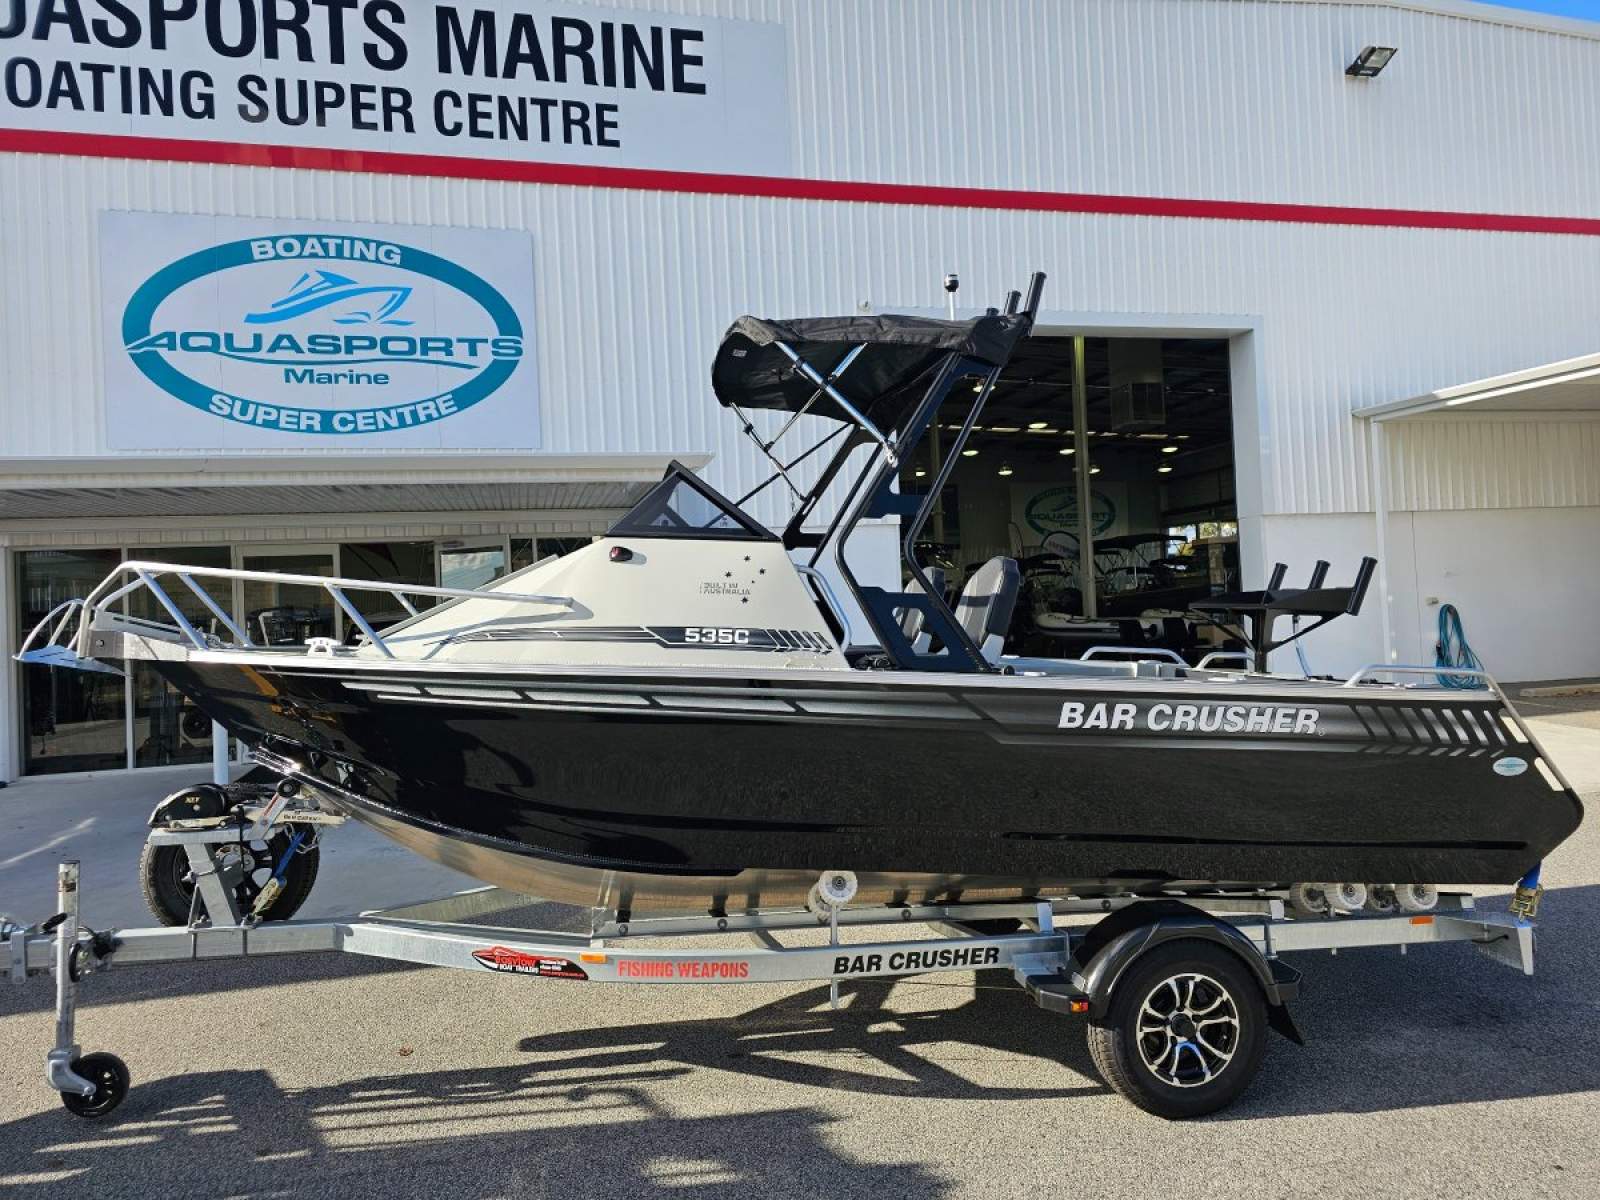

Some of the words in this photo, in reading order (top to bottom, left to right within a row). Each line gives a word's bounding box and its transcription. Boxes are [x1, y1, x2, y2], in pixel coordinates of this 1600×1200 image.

[436, 5, 706, 95] MARINE
[238, 74, 416, 134] SUPER
[434, 89, 620, 148] CENTRE
[250, 237, 401, 265] BOATING
[126, 331, 523, 358] AQUASPORTS
[284, 368, 389, 385] Marine
[208, 393, 321, 432] SUPER
[333, 392, 458, 432] CENTRE
[684, 627, 749, 643] 535C
[1057, 701, 1137, 730] BAR
[1147, 703, 1321, 735] CRUSHER
[617, 960, 674, 977] FISHING
[677, 961, 749, 978] WEAPONS
[833, 955, 881, 975] BAR
[889, 947, 1000, 969] CRUSHER
